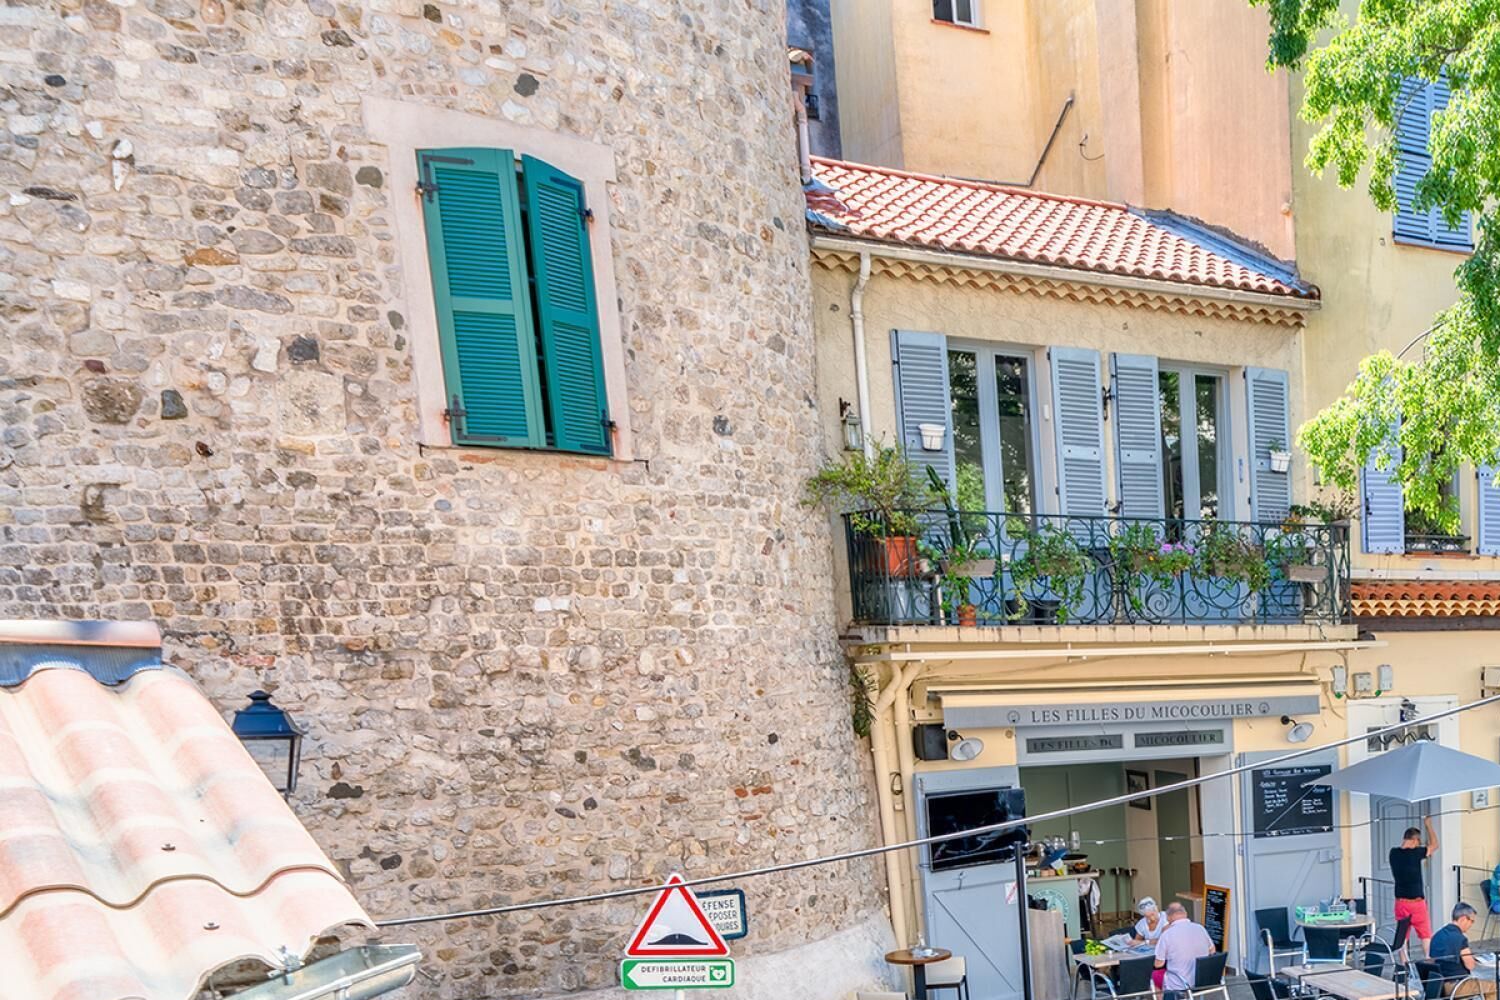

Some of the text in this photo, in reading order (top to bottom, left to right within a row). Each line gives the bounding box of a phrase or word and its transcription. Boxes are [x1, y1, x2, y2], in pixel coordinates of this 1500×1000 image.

[1031, 703, 1254, 723] LES FILLES DU MICOCOULIER
[702, 899, 734, 911] EFENSE
[641, 965, 706, 973] DEFIBRILLATEUR
[662, 975, 706, 983] CARDIAQUE
